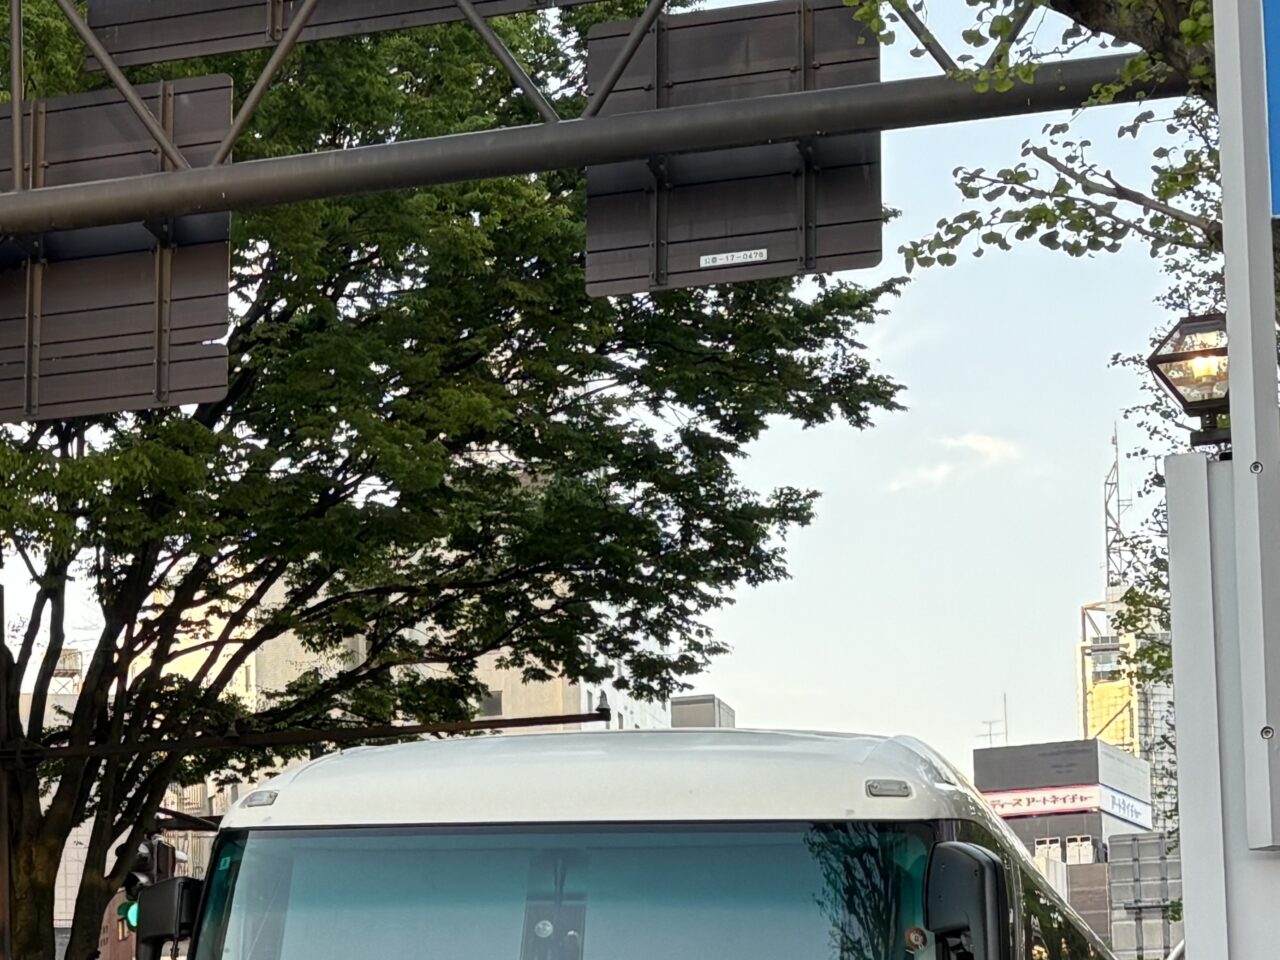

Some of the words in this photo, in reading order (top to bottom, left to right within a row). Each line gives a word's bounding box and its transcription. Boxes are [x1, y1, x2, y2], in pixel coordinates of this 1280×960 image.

[1025, 793, 1095, 807] アートネイチャー
